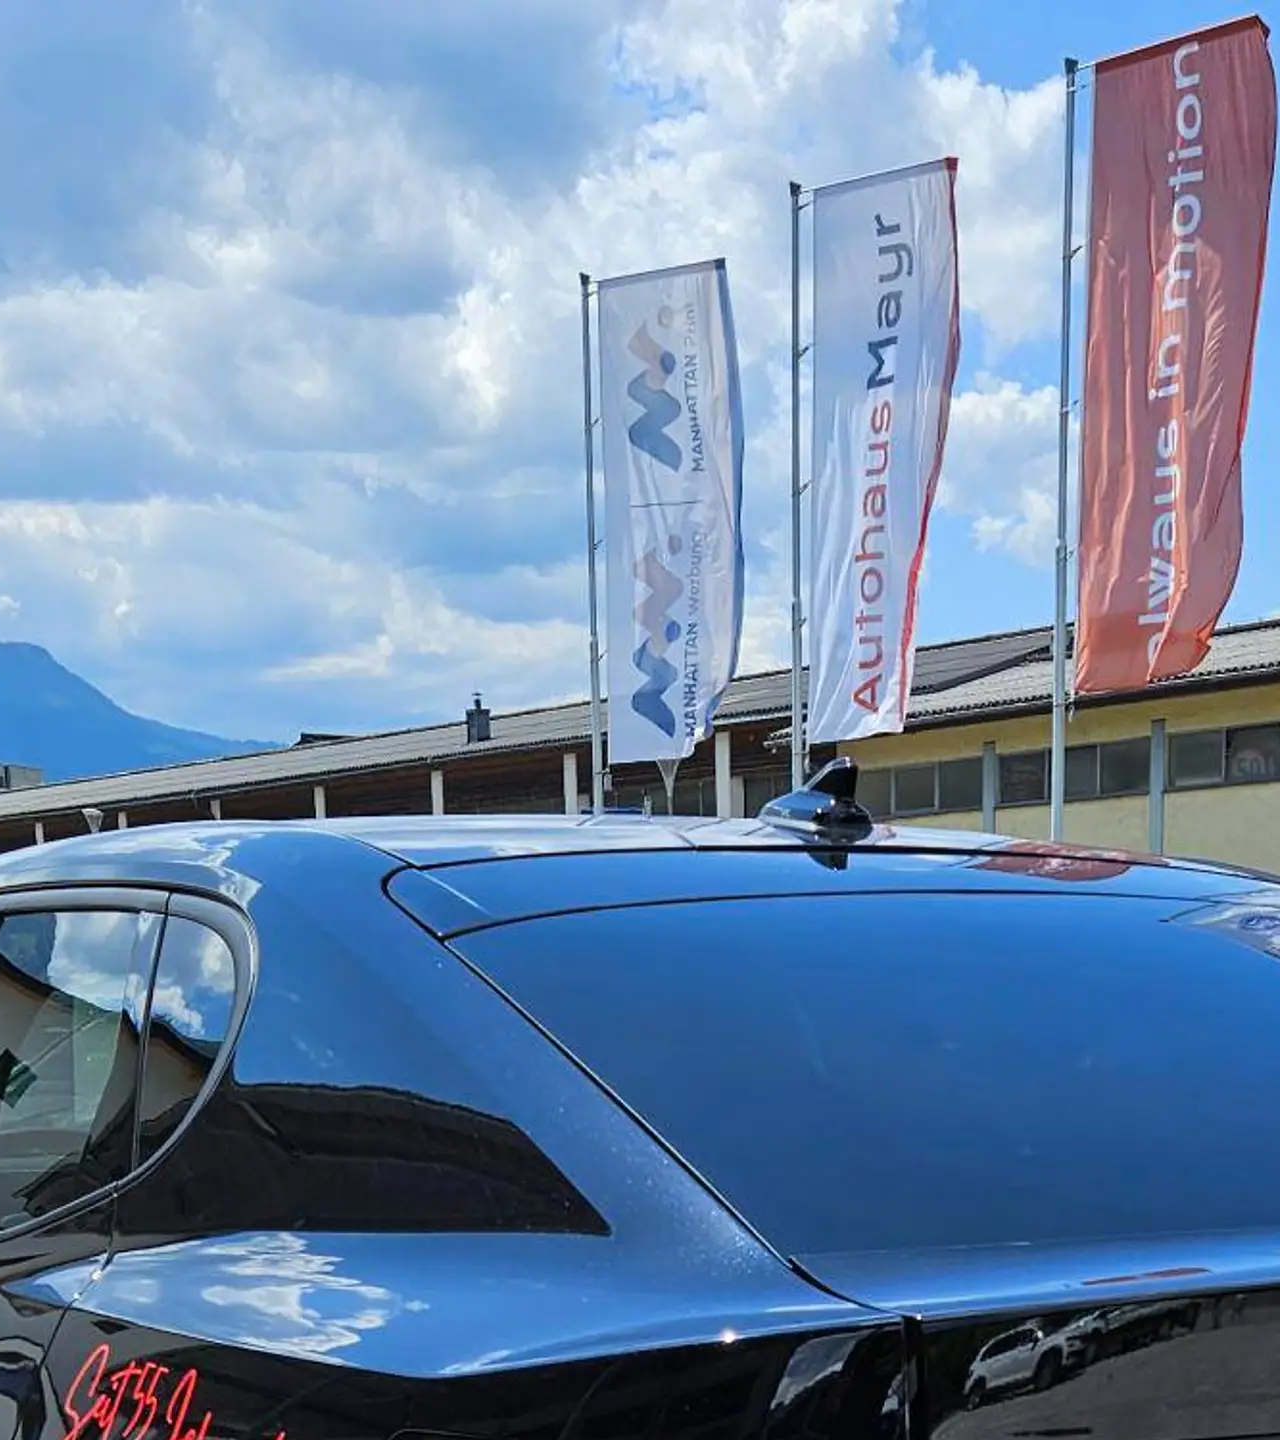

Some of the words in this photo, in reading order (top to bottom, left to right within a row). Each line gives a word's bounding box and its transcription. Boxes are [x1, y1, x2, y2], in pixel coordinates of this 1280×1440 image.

[1162, 40, 1205, 312] motion
[867, 213, 913, 391] Mayr
[1149, 336, 1182, 401] in
[683, 355, 705, 472] MANHATTAN
[853, 404, 892, 714] Autohaus
[683, 623, 701, 738] MANHATTAN
